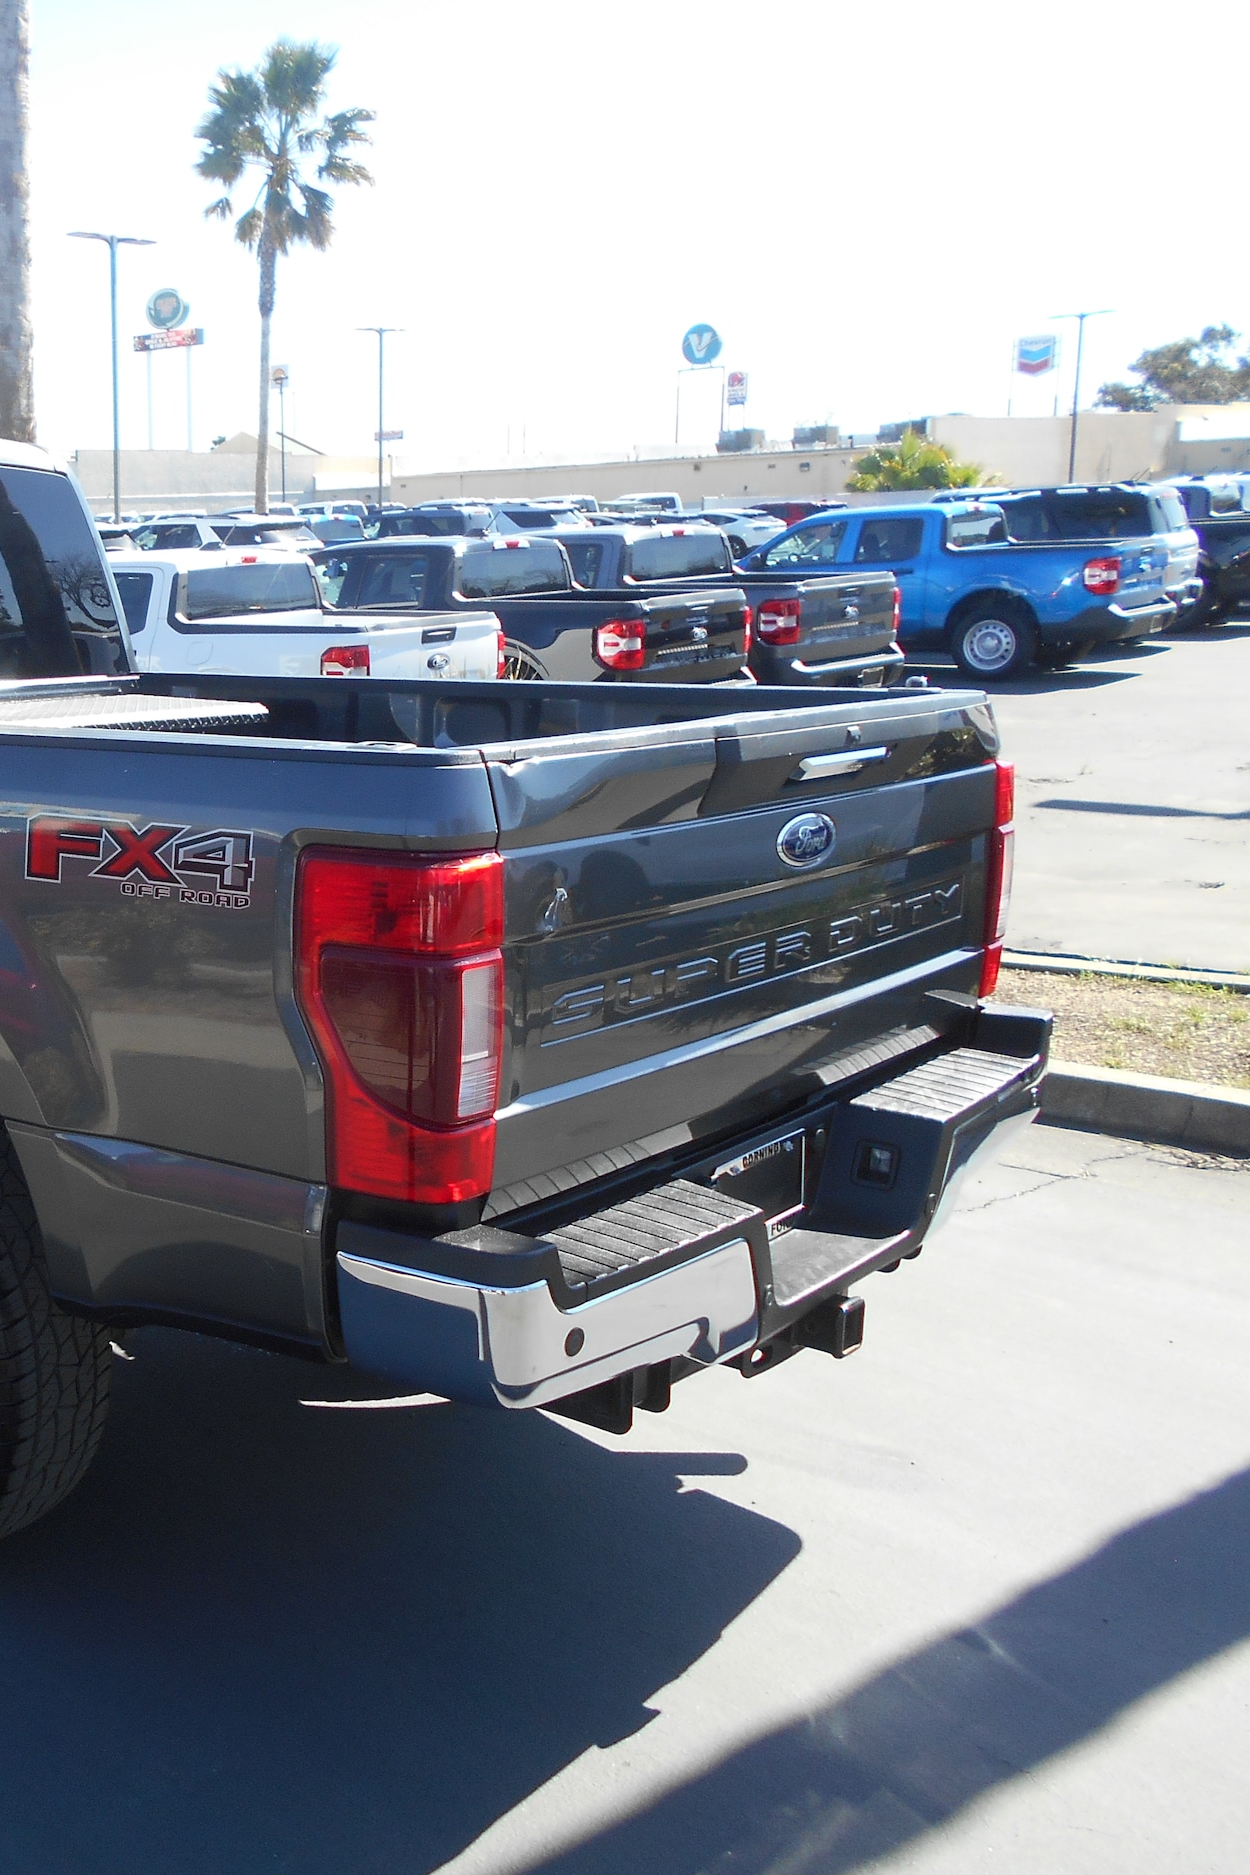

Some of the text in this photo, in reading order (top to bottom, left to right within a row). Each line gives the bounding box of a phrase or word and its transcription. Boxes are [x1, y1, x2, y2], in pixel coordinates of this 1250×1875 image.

[25, 812, 256, 894] FX4
[120, 882, 251, 910] OFF ROAD
[551, 883, 960, 1026] SUPER DUTY
